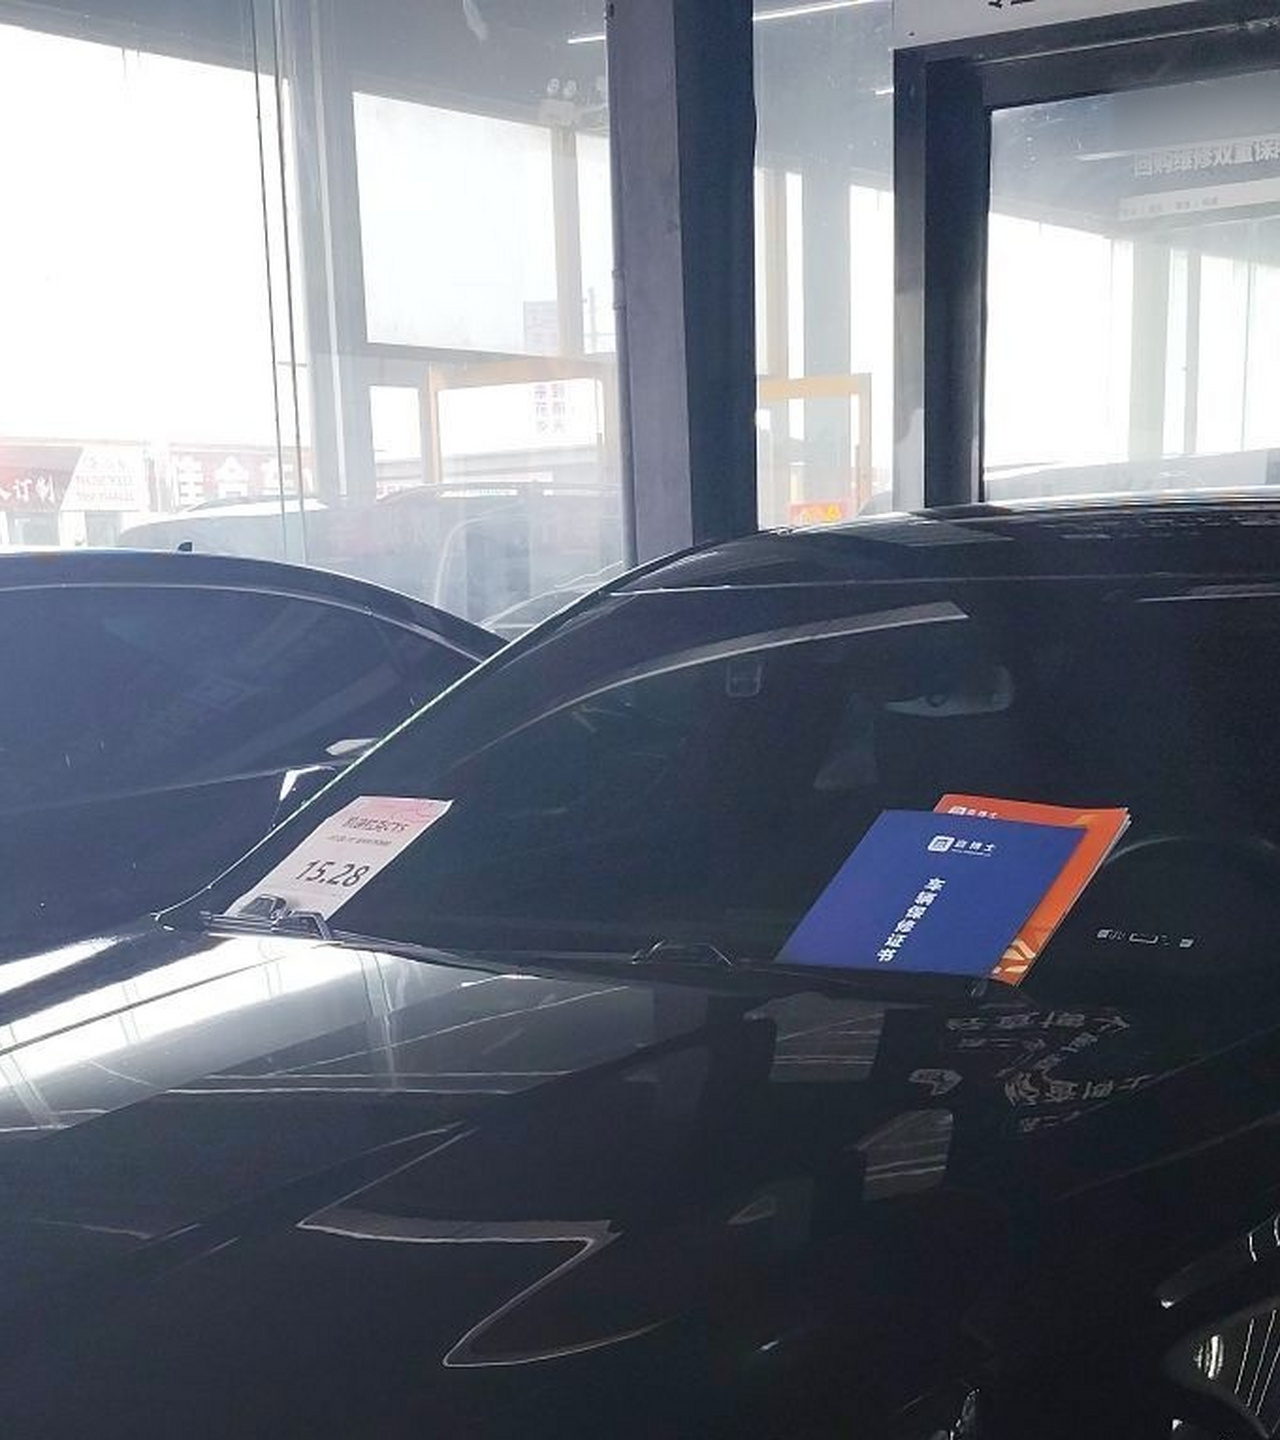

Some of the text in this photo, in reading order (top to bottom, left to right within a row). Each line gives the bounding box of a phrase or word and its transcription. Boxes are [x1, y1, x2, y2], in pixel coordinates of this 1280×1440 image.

[295, 859, 372, 888] 15.28
[876, 877, 946, 962] 车辆保修证书
